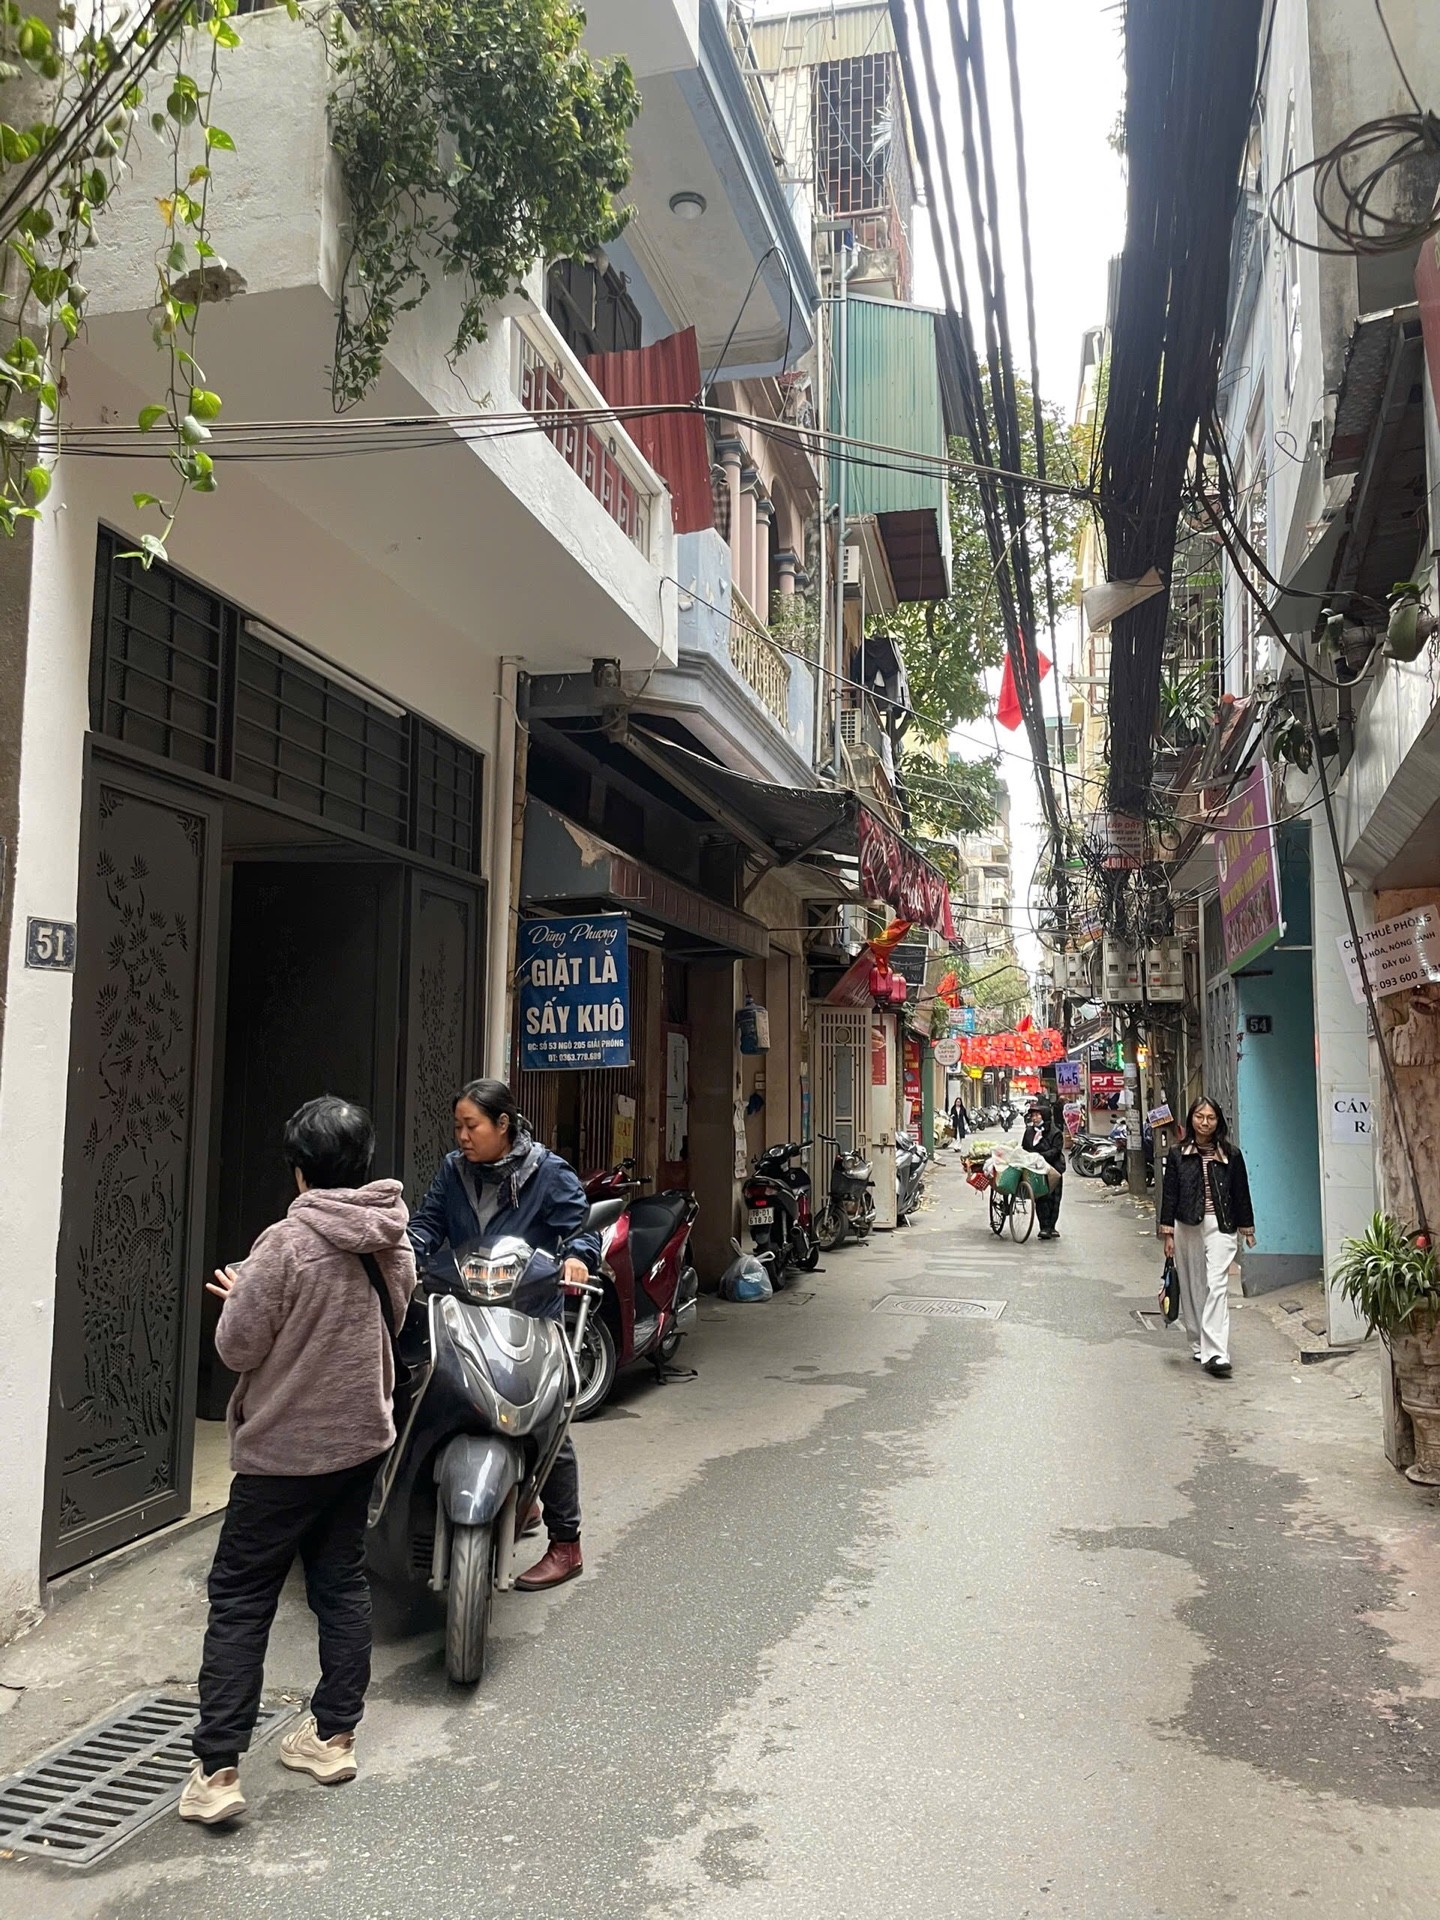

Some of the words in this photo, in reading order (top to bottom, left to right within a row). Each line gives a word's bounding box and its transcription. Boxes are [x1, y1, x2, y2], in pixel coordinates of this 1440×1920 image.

[528, 925, 566, 949] Dũng
[569, 923, 618, 946] Phượng
[1366, 924, 1392, 942] THUÊ
[35, 926, 65, 961] 51
[531, 952, 582, 991] GIẶT
[589, 950, 618, 984] LÀ
[1381, 958, 1397, 970] ĐẦY
[1399, 954, 1411, 965] ĐỦ
[1379, 976, 1397, 989] 093
[1399, 971, 1418, 983] 600
[526, 997, 570, 1034] SẤY
[577, 997, 624, 1033] KHÔ
[1250, 1017, 1267, 1032] 54
[573, 1041, 586, 1050] 205
[601, 1038, 624, 1048] PHÓNG
[1354, 1121, 1371, 1133] R
